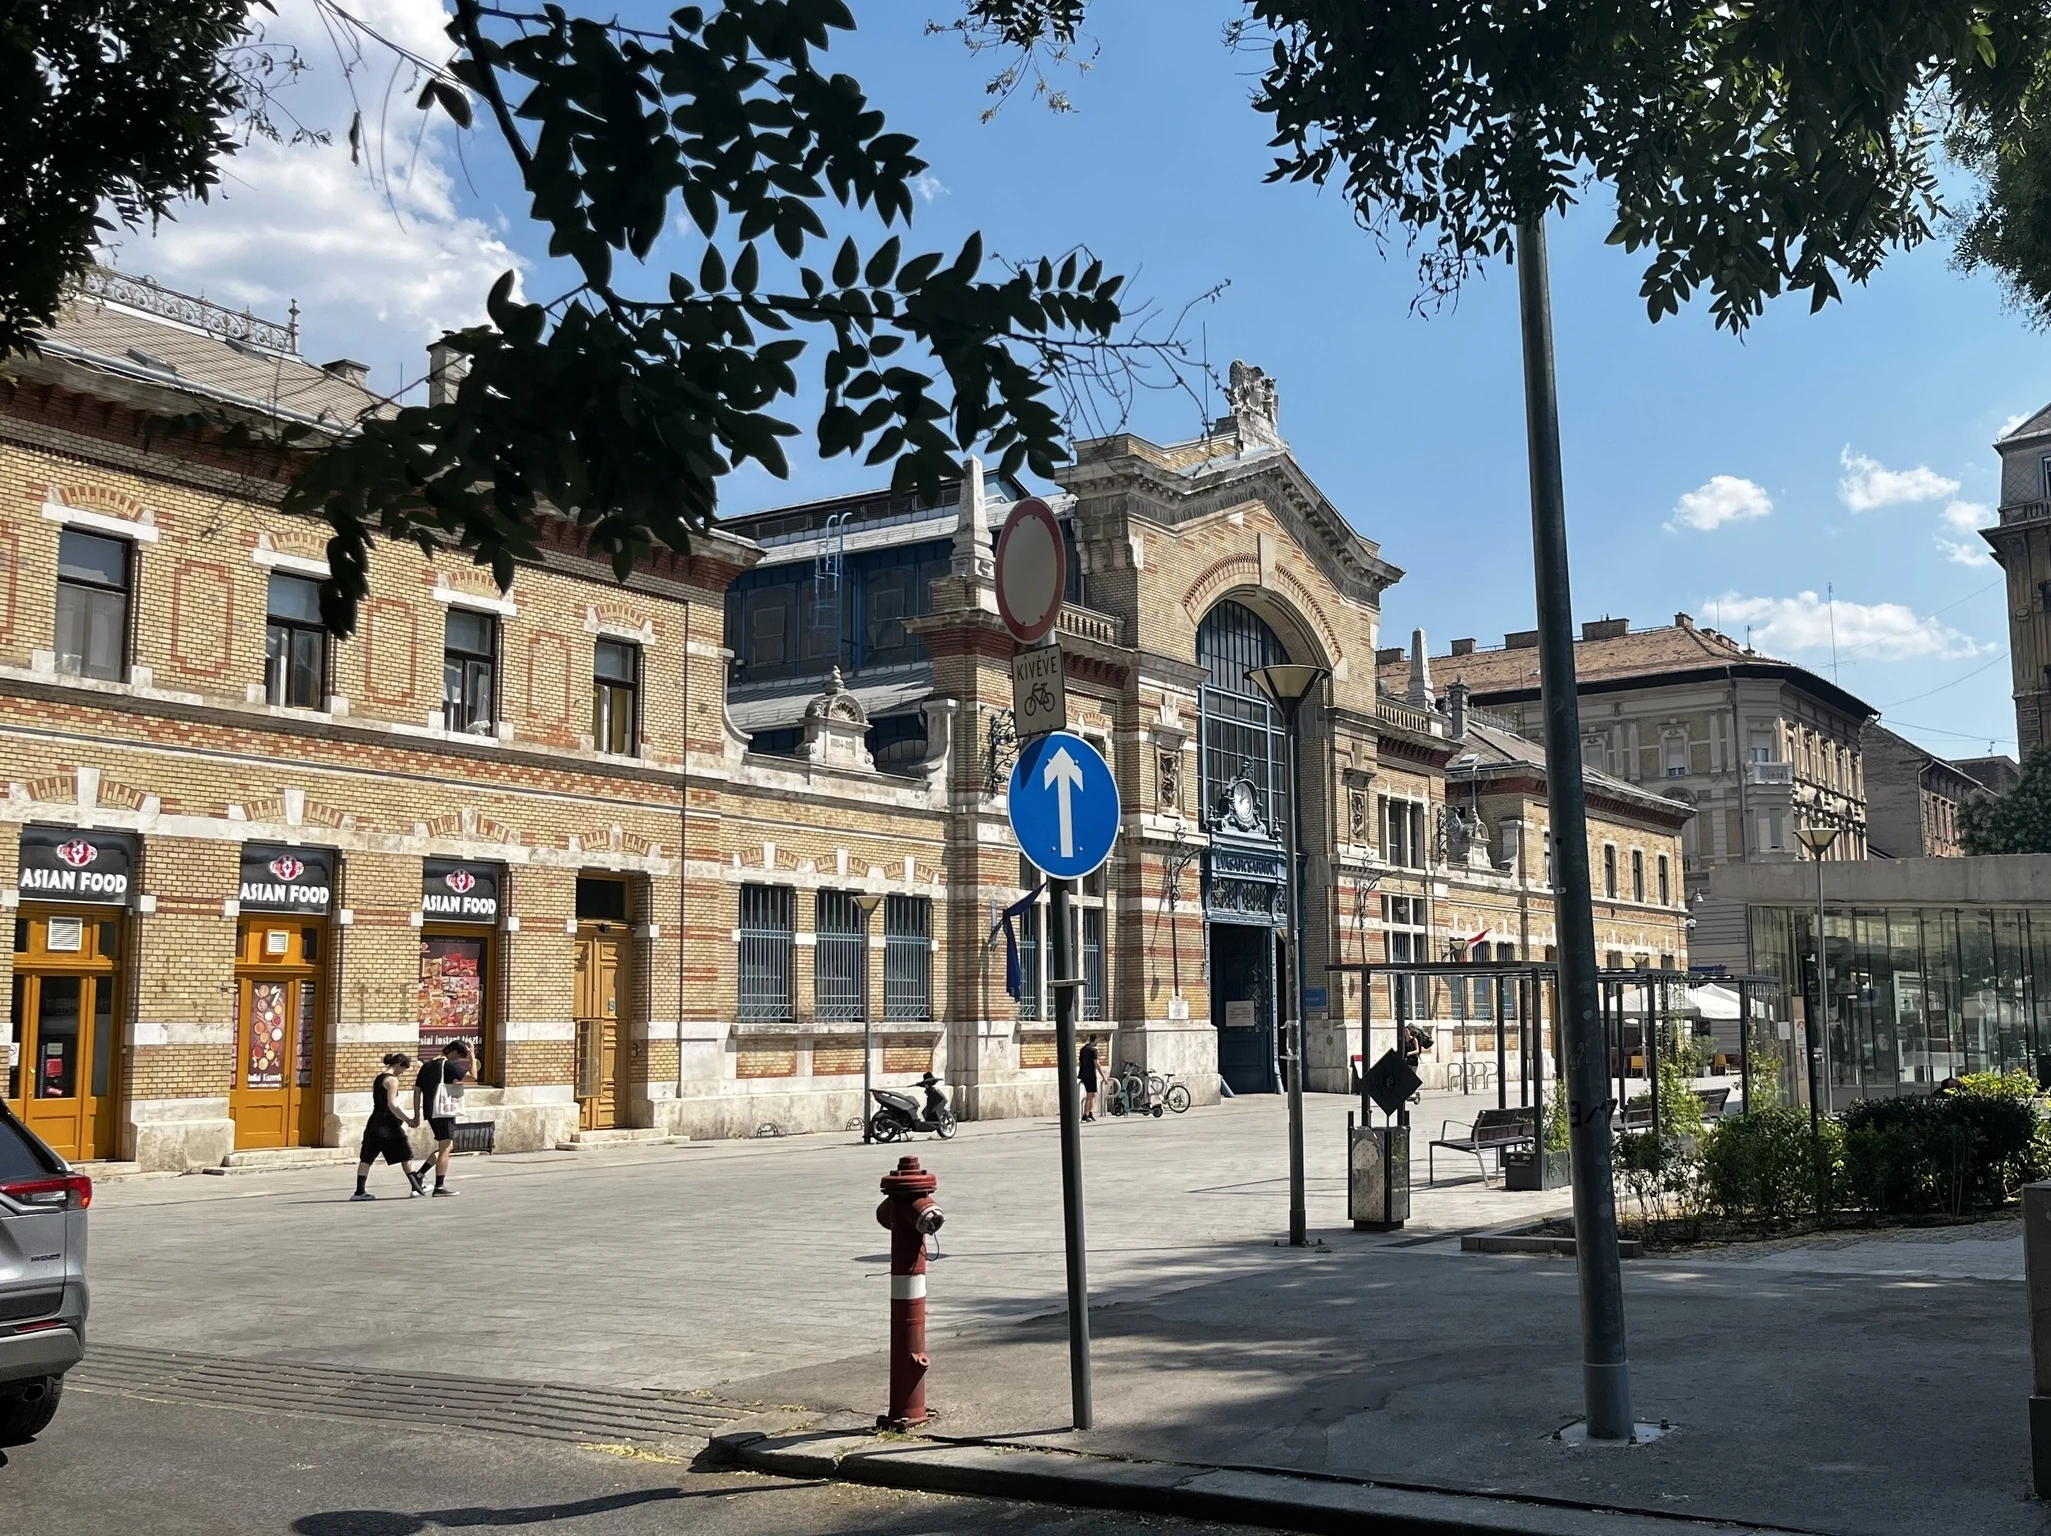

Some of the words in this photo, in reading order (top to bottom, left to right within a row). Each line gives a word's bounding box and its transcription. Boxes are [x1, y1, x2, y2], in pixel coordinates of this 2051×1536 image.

[20, 868, 76, 890] ASIAN
[80, 872, 127, 893] FOOD
[239, 883, 286, 902] ASIAN
[289, 885, 329, 904] FOOD
[422, 895, 461, 912] ASIAN
[463, 897, 496, 914] FOOD
